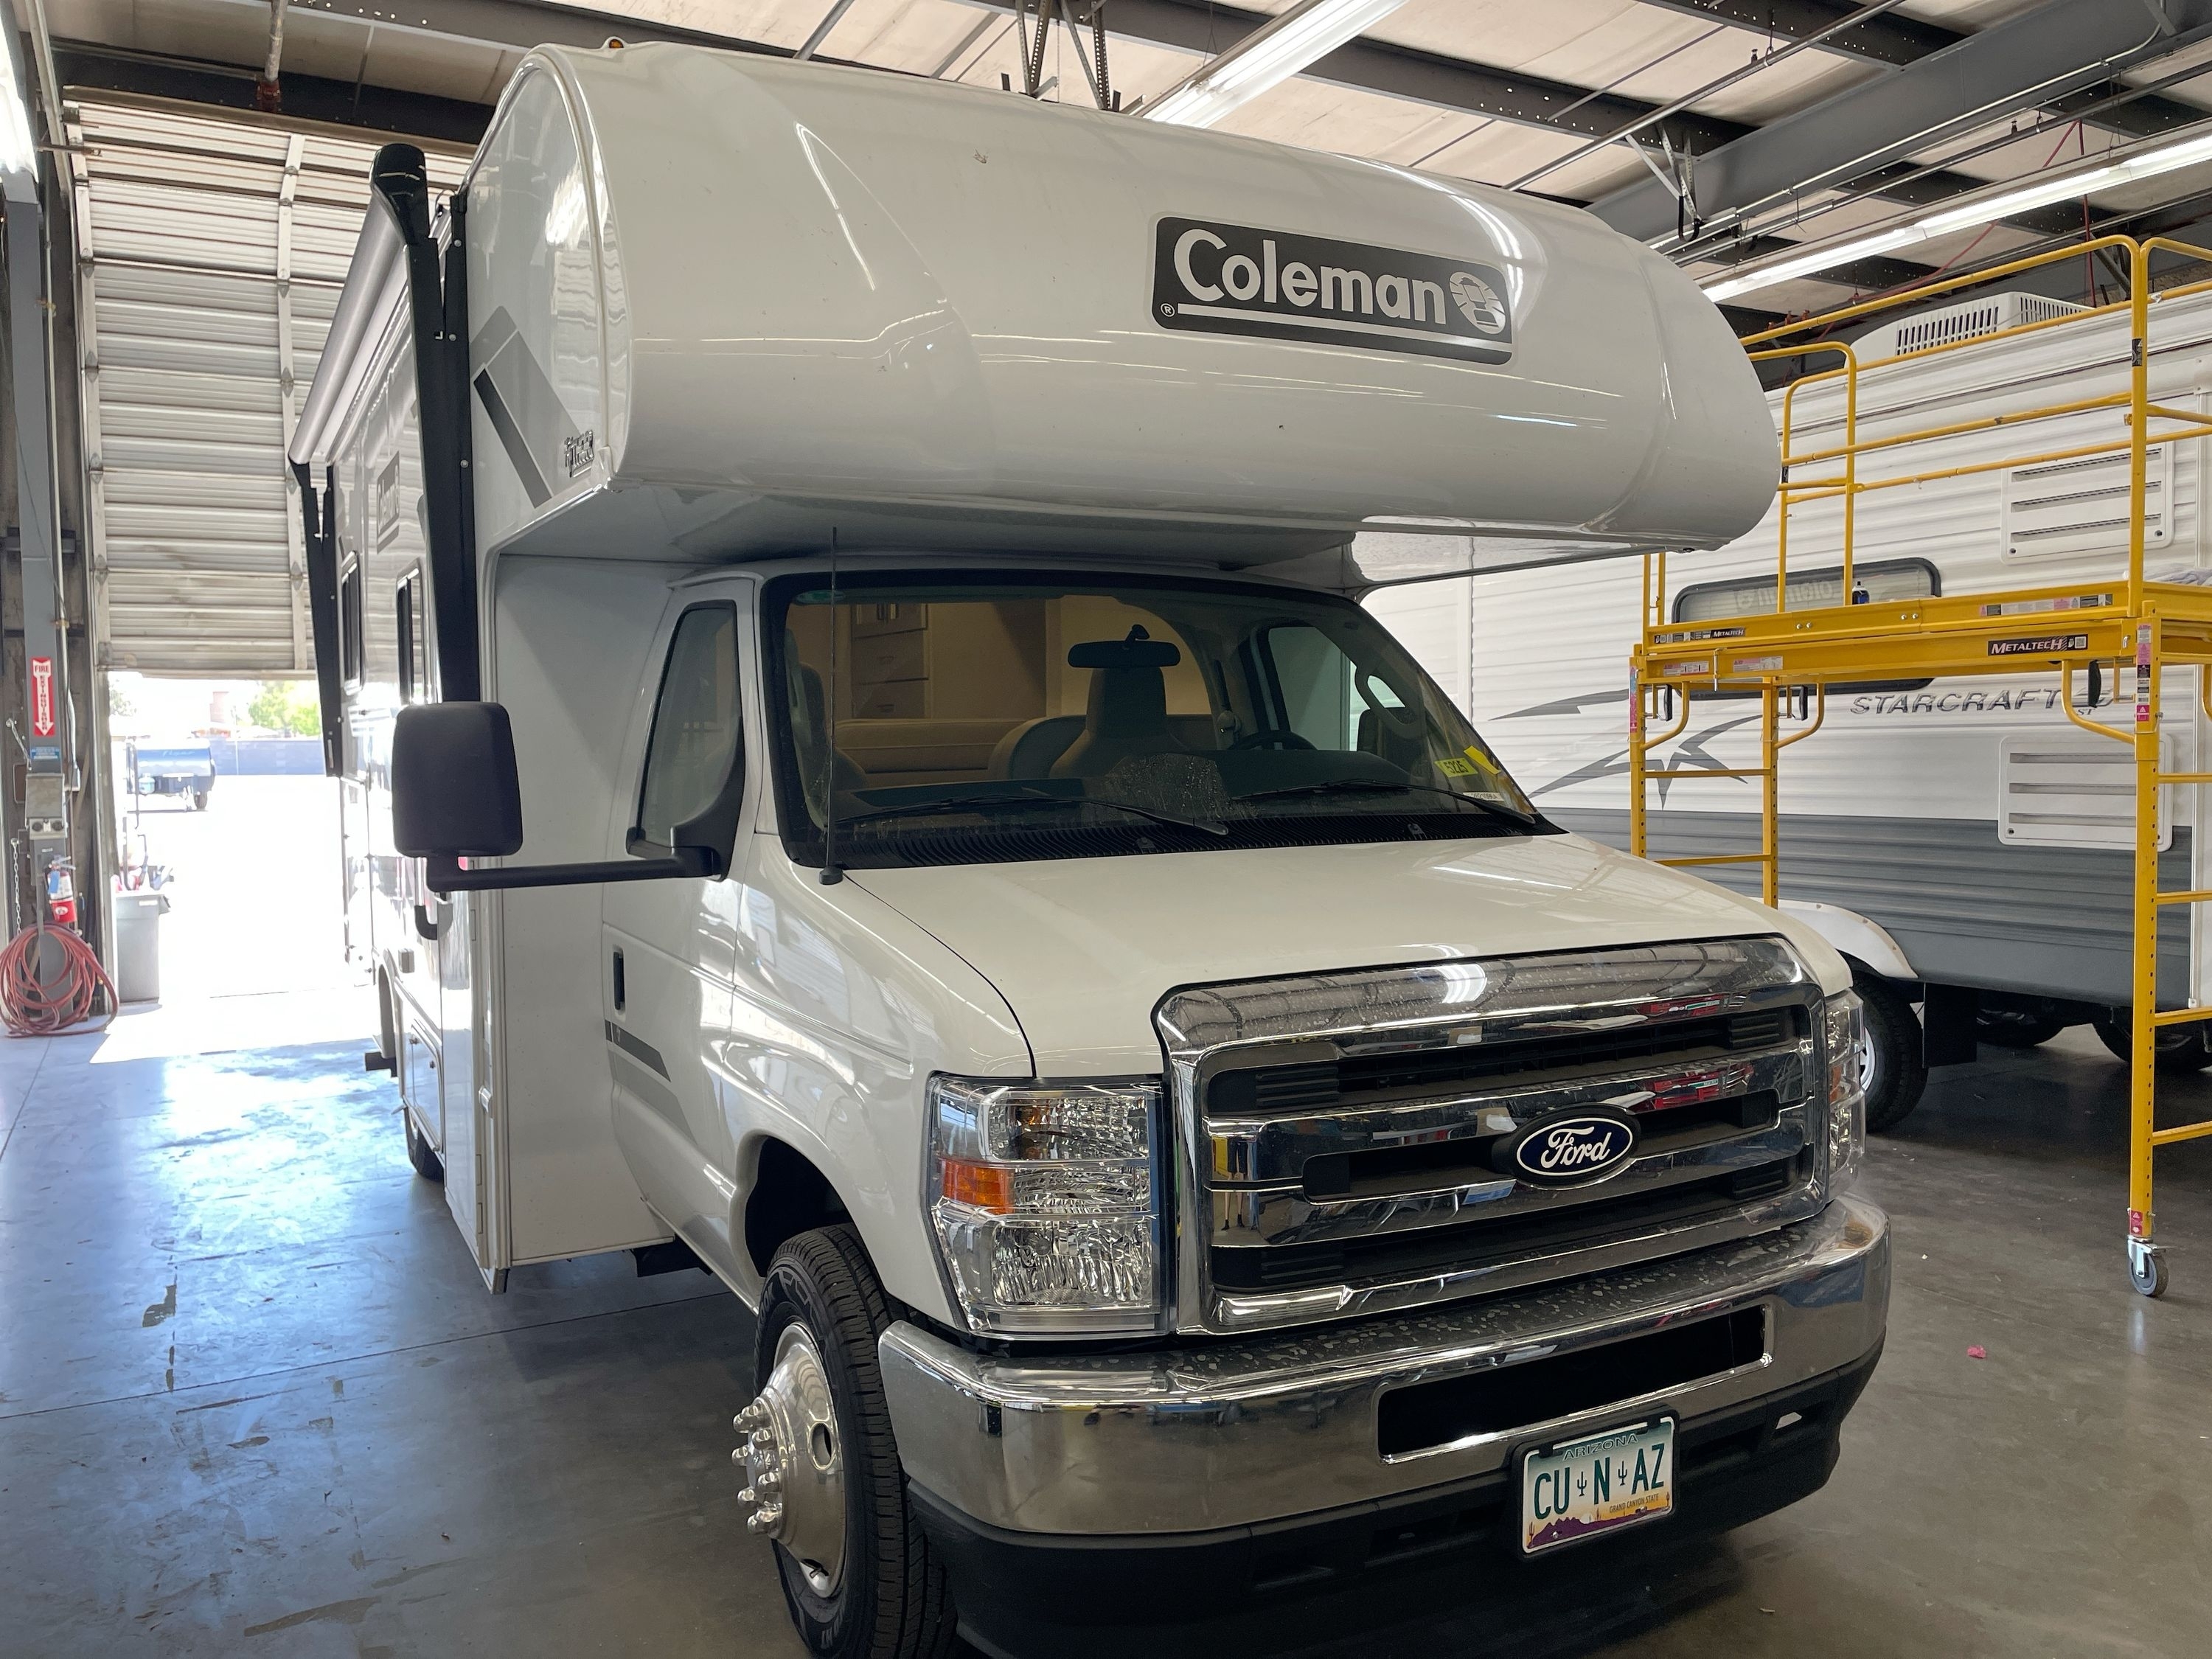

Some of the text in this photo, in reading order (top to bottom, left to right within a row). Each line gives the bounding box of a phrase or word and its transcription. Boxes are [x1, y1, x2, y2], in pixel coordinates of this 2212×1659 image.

[1173, 228, 1447, 325] Coleman
[1713, 629, 1744, 639] METALTECH
[1991, 639, 2063, 655] METALTECH
[1850, 688, 2063, 714] STARCRAFT
[1540, 1126, 1613, 1169] Ford
[1563, 1433, 1639, 1461] ARIZONA
[1534, 1443, 1665, 1520] CU N AZ
[1609, 1493, 1659, 1513] GRAND CANYON STATE
